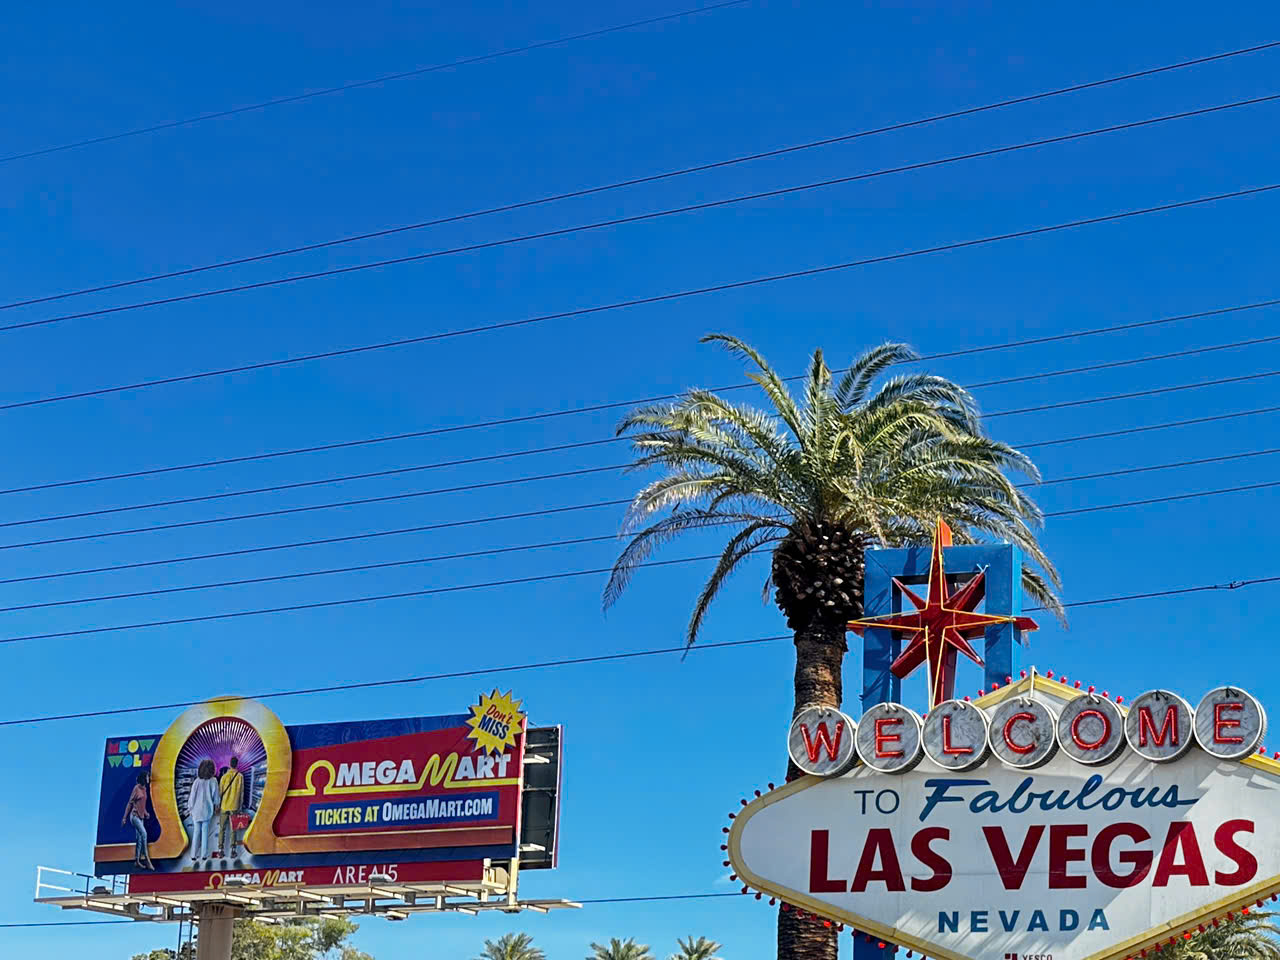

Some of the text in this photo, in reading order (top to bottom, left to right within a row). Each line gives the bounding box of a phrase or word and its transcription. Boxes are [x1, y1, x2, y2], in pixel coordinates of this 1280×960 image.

[486, 703, 514, 725] Don't
[478, 714, 510, 740] MISS
[801, 703, 1245, 763] WELCOME
[107, 739, 155, 754] MEOW
[107, 754, 153, 768] WOLF
[418, 752, 511, 790] MART
[854, 774, 1200, 822] TO Fabulous
[315, 806, 362, 826] TICKETS
[364, 805, 380, 823] AT
[809, 818, 1258, 894] LAS VEGAS
[261, 869, 305, 887] MART
[938, 908, 1111, 933] NEVADA
